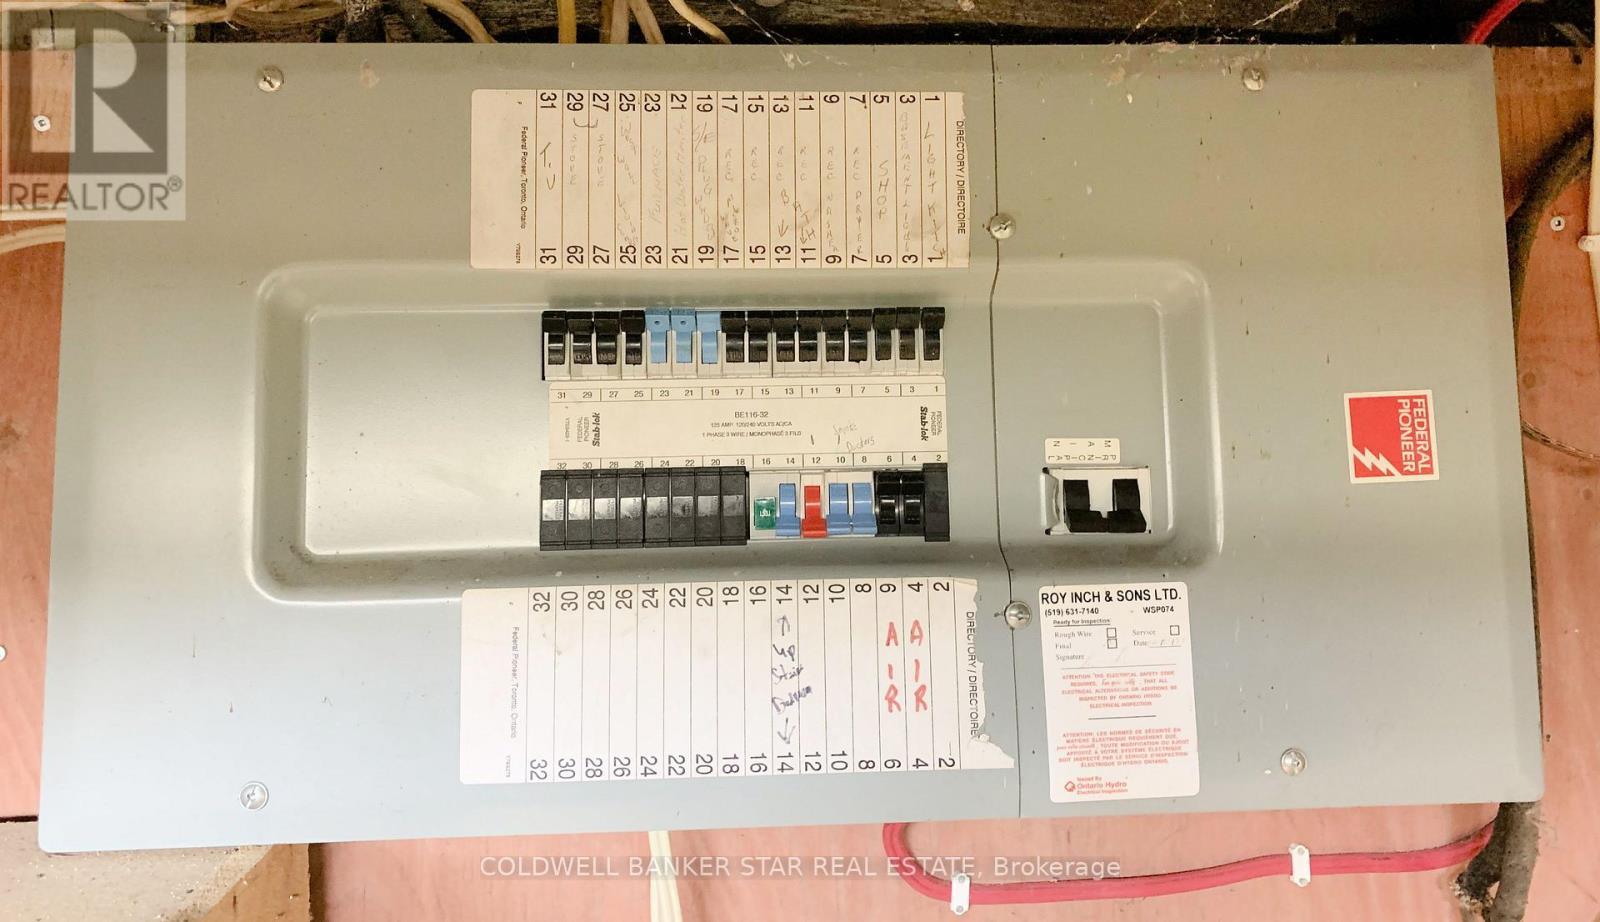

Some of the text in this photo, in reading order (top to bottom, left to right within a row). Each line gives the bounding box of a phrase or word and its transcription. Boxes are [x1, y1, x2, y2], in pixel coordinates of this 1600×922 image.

[540, 93, 557, 108] 31
[567, 93, 583, 111] 29
[593, 93, 609, 111] 27
[619, 93, 635, 111] 25
[645, 94, 660, 112] 23
[671, 94, 687, 109] 21
[697, 95, 713, 112] 19
[722, 95, 737, 112] 17
[748, 95, 764, 112] 15
[773, 95, 789, 113] 13
[799, 96, 814, 110] 11
[824, 95, 839, 103] 9
[850, 95, 866, 103] 7
[874, 95, 889, 103] 5
[900, 95, 915, 103] 3
[520, 152, 528, 177] Pioneer,
[956, 121, 965, 234] DIRECTORY DIRECTOIRE
[877, 160, 890, 220] SHOP
[540, 249, 556, 264] 31
[567, 246, 583, 263] 29
[593, 246, 609, 263] 27
[620, 245, 636, 263] 25
[645, 246, 661, 264] 23
[672, 249, 687, 264] 21
[698, 246, 714, 263] 19
[723, 245, 739, 263] 17
[750, 246, 765, 263] 15
[775, 246, 791, 263] 13
[801, 248, 816, 263] 11
[826, 255, 841, 263] 9
[852, 255, 867, 263] 7
[876, 255, 891, 263] 5
[902, 255, 918, 263] 3
[928, 253, 943, 262] 1
[608, 390, 619, 398] 27
[634, 390, 644, 398] 25
[684, 389, 694, 397] 21
[735, 388, 745, 396] 17
[784, 387, 794, 395] 13
[1397, 399, 1416, 472] PIONEER
[1413, 398, 1432, 473] FEDERAL
[609, 461, 619, 469] 28
[762, 457, 771, 465] 16
[811, 456, 821, 464] 12
[836, 456, 846, 464] 10
[750, 586, 766, 604] 16
[776, 585, 792, 604] 14
[803, 585, 819, 603] 12
[829, 584, 845, 603] 10
[855, 584, 871, 592] 8
[880, 584, 896, 592] 6
[908, 582, 923, 592] 4
[933, 582, 949, 591] 2
[533, 592, 550, 612] 32
[561, 592, 578, 611] 30
[588, 590, 605, 610] 28
[616, 590, 632, 609] 26
[642, 588, 658, 608] 24
[669, 588, 685, 607] 22
[697, 587, 713, 606] 20
[723, 587, 739, 605] 18
[1042, 588, 1182, 604] ROY INCH & SONS LTD.
[1044, 607, 1099, 617] (519) 631-7140
[1143, 606, 1174, 614] WSP074
[511, 626, 519, 652] Federal
[1055, 628, 1076, 639] Rough
[884, 622, 902, 713] AIR
[910, 620, 927, 713] AIR
[968, 676, 979, 736] DIRECTOIRE
[530, 760, 547, 780] 32
[559, 759, 575, 778] 30
[586, 758, 602, 778] 28
[614, 757, 630, 777] 26
[641, 756, 657, 777] 24
[668, 755, 685, 775] 22
[696, 754, 713, 774] 20
[723, 755, 739, 773] 18
[750, 753, 767, 772] 16
[778, 753, 793, 772] 14
[805, 752, 821, 771] 12
[831, 752, 848, 770] 10
[859, 760, 875, 769] 8
[884, 760, 901, 768] 6
[913, 758, 928, 768] 4
[939, 758, 955, 767] 2
[1106, 781, 1127, 789] Hydro
